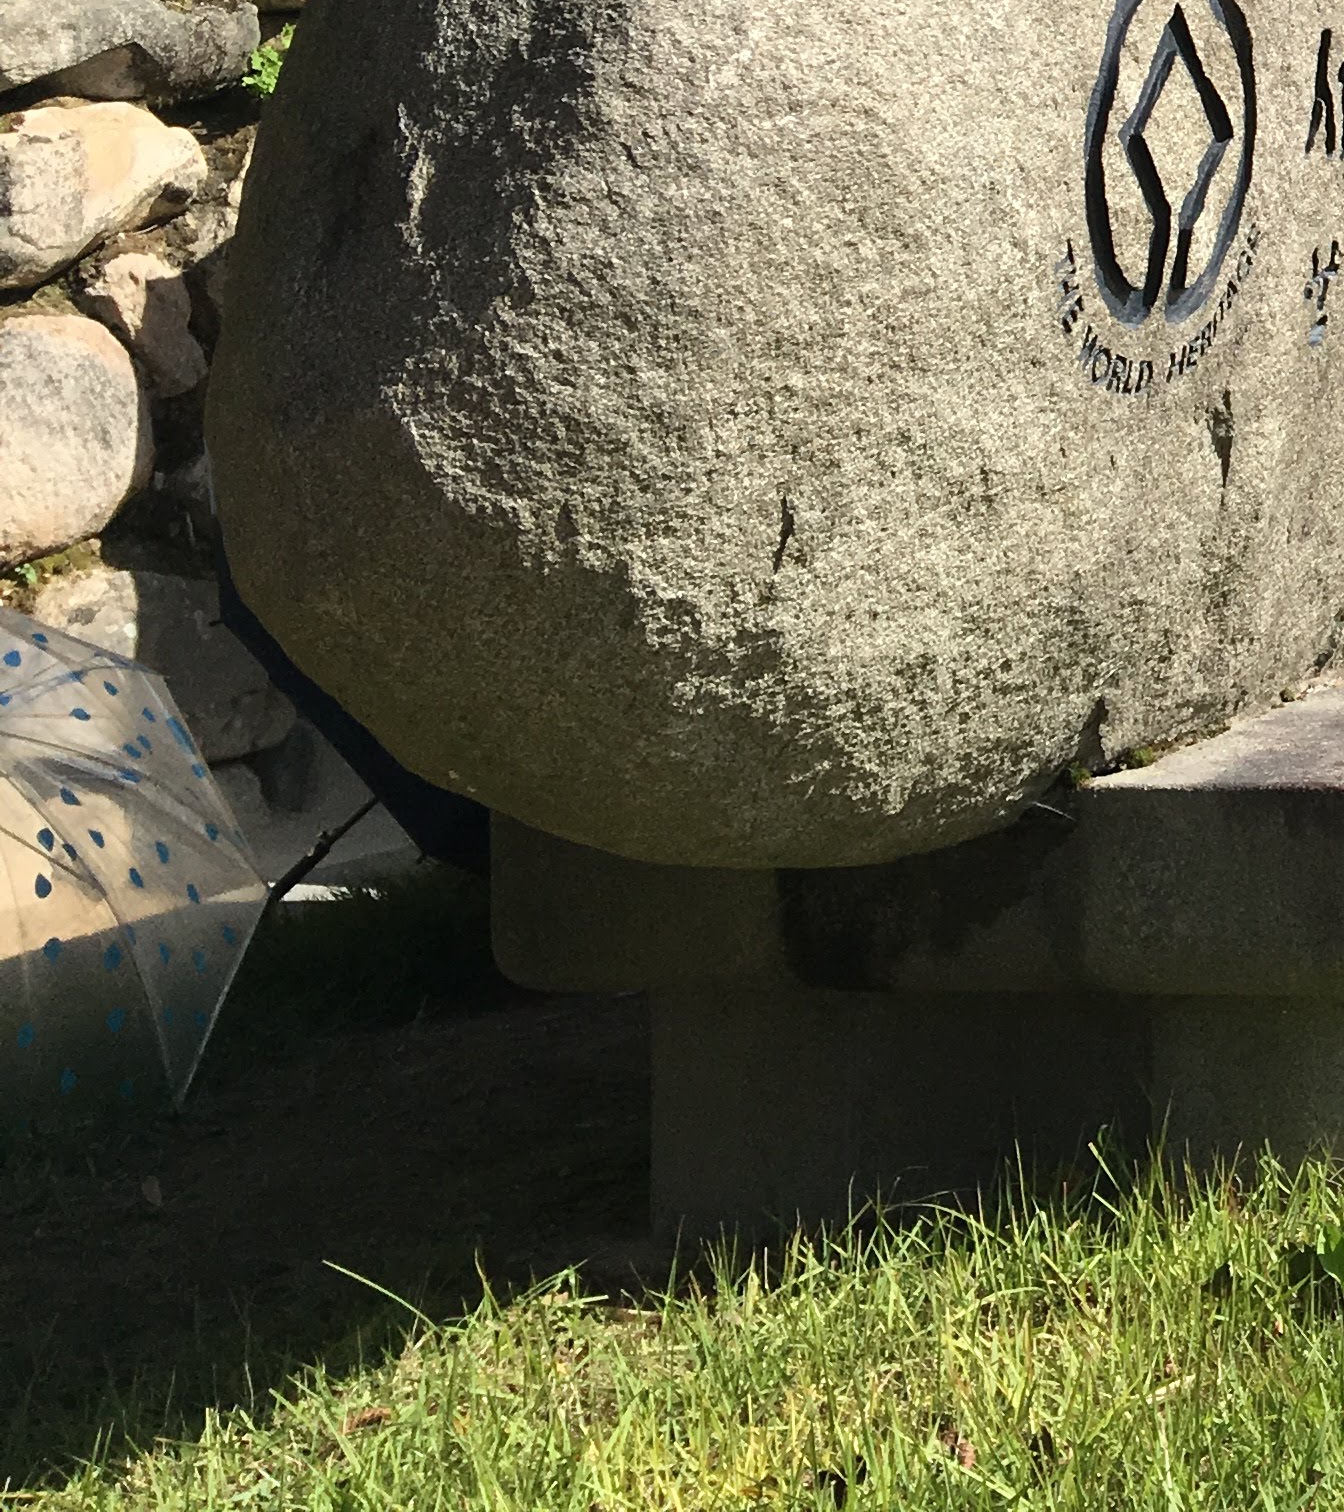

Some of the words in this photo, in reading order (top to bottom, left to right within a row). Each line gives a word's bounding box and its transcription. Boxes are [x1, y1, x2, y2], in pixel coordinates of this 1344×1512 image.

[1054, 237, 1085, 334] THE
[1078, 324, 1154, 395] WORLD
[1165, 221, 1262, 384] HERITAGE
